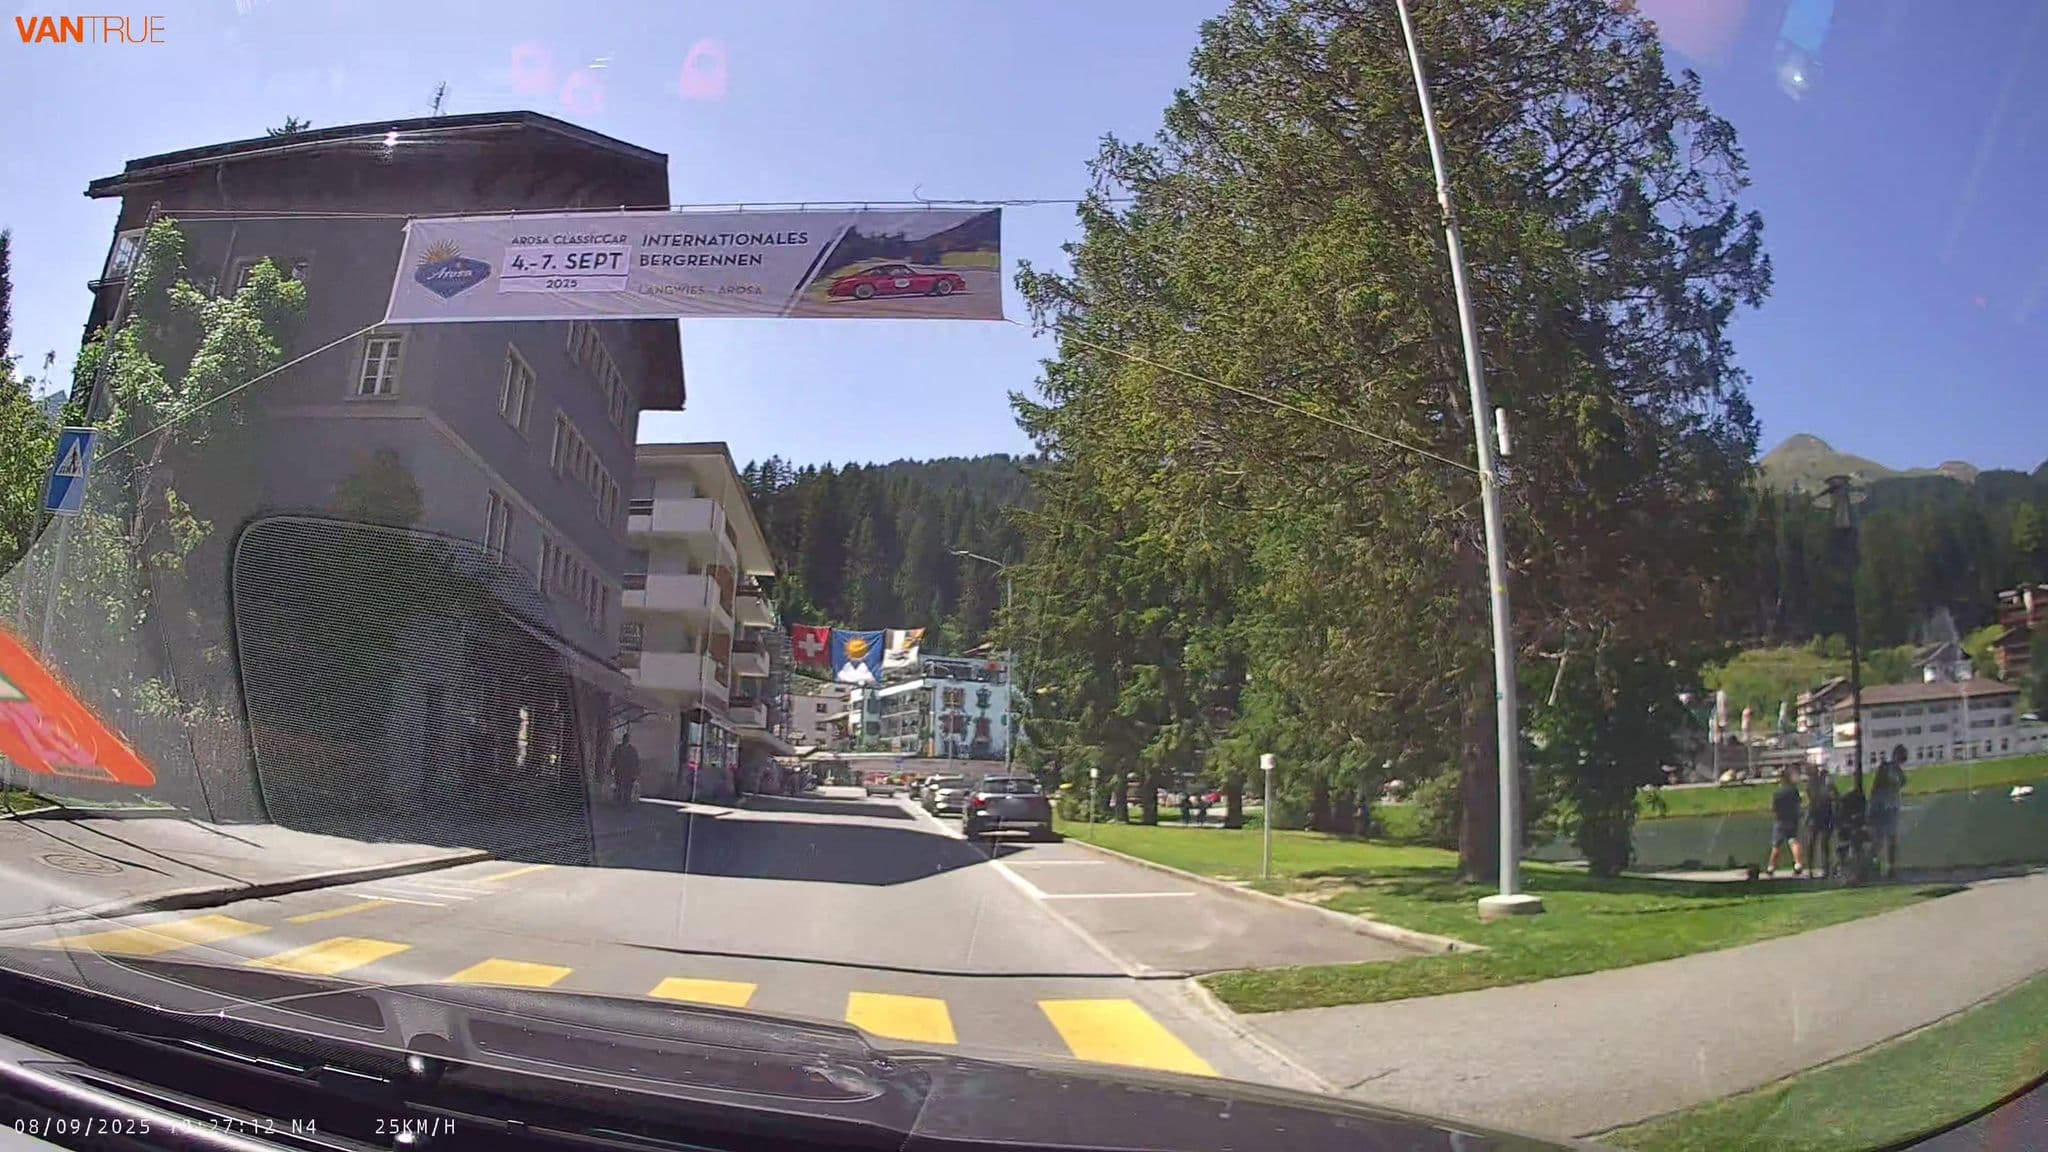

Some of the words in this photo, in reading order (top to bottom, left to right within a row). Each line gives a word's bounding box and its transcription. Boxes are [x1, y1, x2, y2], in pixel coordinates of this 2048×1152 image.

[511, 235, 550, 245] AROSA
[642, 232, 808, 247] INTERNATIONALES
[565, 252, 623, 271] SEPT
[640, 253, 762, 267] BERGRENNEN
[546, 279, 578, 289] 2025
[718, 284, 763, 295] AROSA
